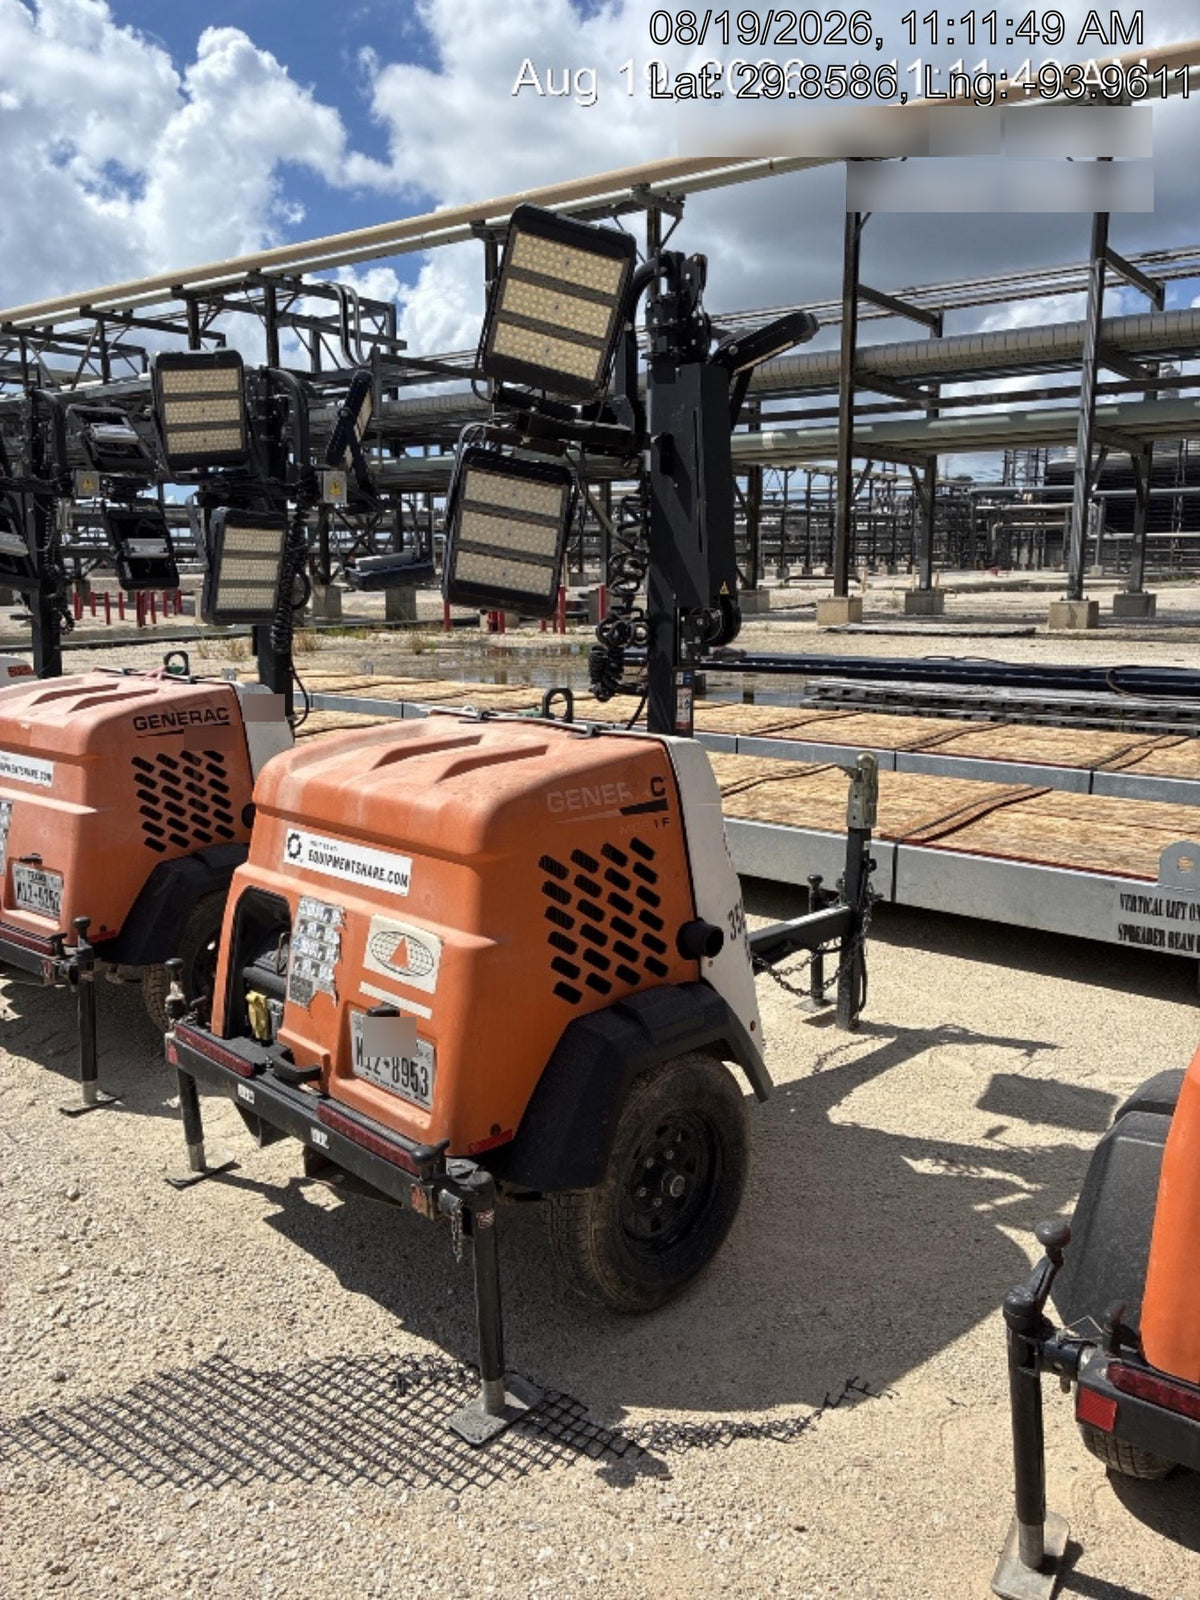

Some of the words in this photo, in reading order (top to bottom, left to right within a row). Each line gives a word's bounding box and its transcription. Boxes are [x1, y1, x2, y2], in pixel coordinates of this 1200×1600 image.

[133, 707, 230, 731] GENERAC
[308, 849, 408, 888] EQUIPMENTSHARE.COM
[1120, 892, 1163, 916] VERTICAL
[1166, 899, 1188, 920] LIFT
[1118, 922, 1165, 948] SPREADER
[1168, 931, 1193, 952] BEAM
